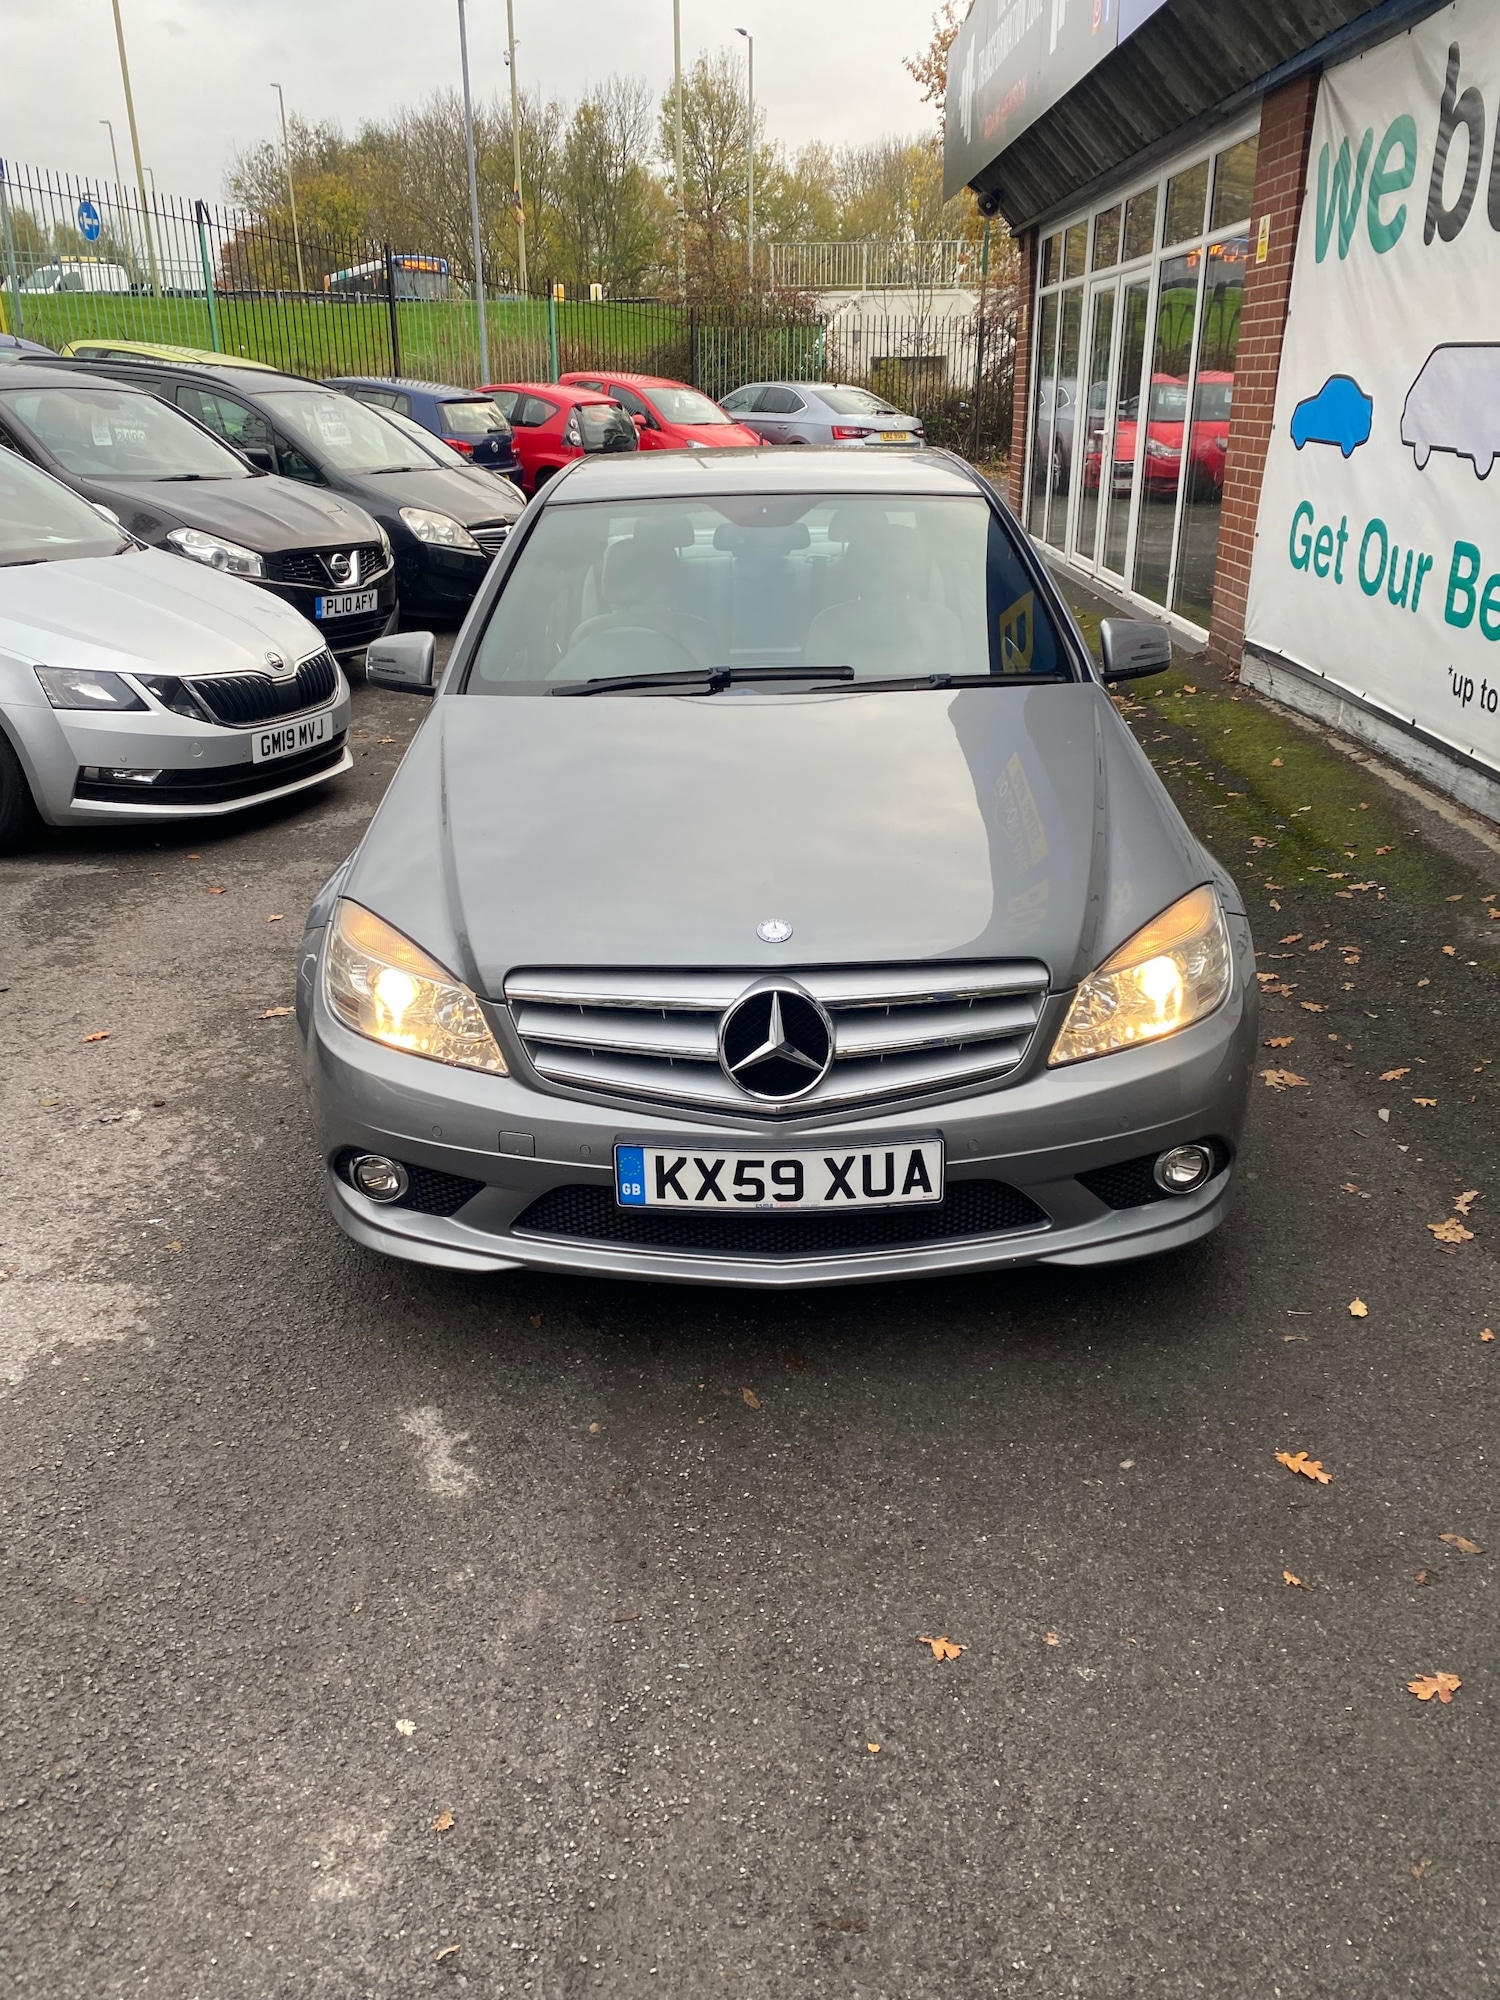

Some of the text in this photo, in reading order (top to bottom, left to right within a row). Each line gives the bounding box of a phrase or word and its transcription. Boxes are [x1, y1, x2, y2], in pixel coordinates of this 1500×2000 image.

[1289, 500, 1348, 584] Get
[1358, 518, 1433, 613] Our
[326, 593, 374, 615] PL10 AFY
[1480, 678, 1498, 713] to
[261, 718, 324, 757] GM19 MVJ
[622, 1183, 641, 1195] GB
[655, 1149, 933, 1202] KX59 XUA
